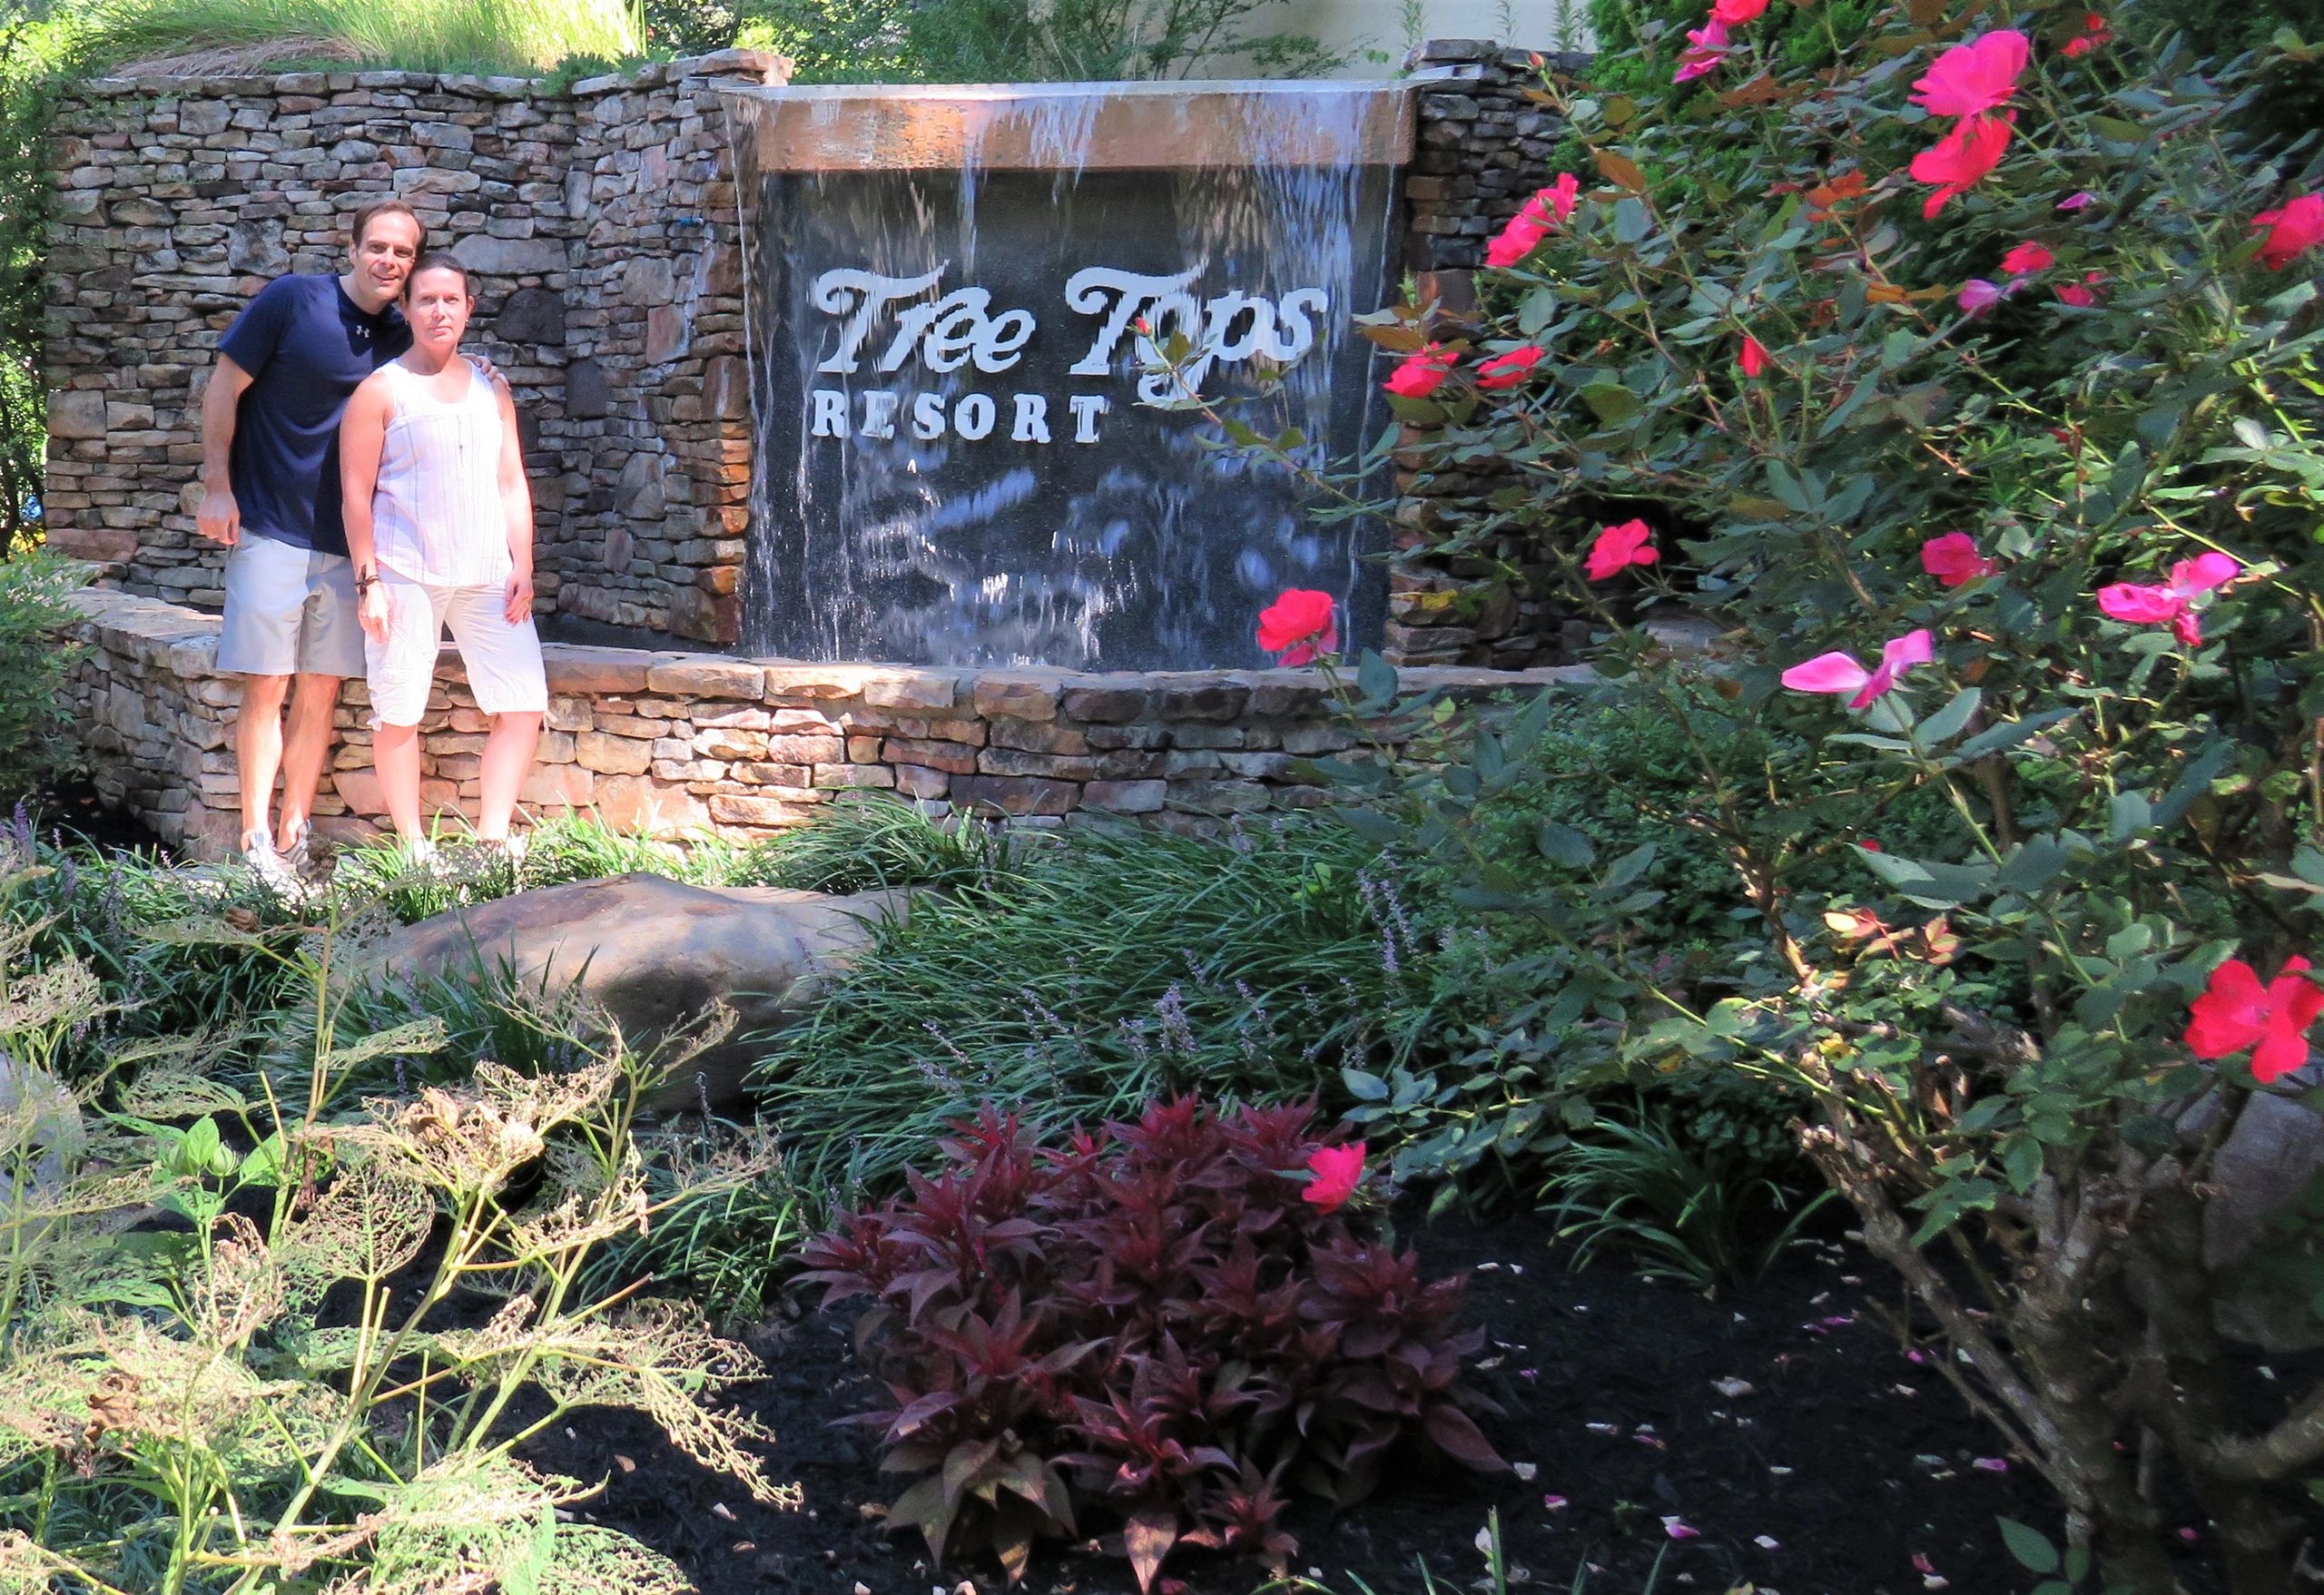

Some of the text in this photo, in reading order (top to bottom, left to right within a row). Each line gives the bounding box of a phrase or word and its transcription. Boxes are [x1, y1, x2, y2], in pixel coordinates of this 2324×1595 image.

[813, 258, 1328, 404] Tree Tops
[811, 389, 1109, 444] RESORT
